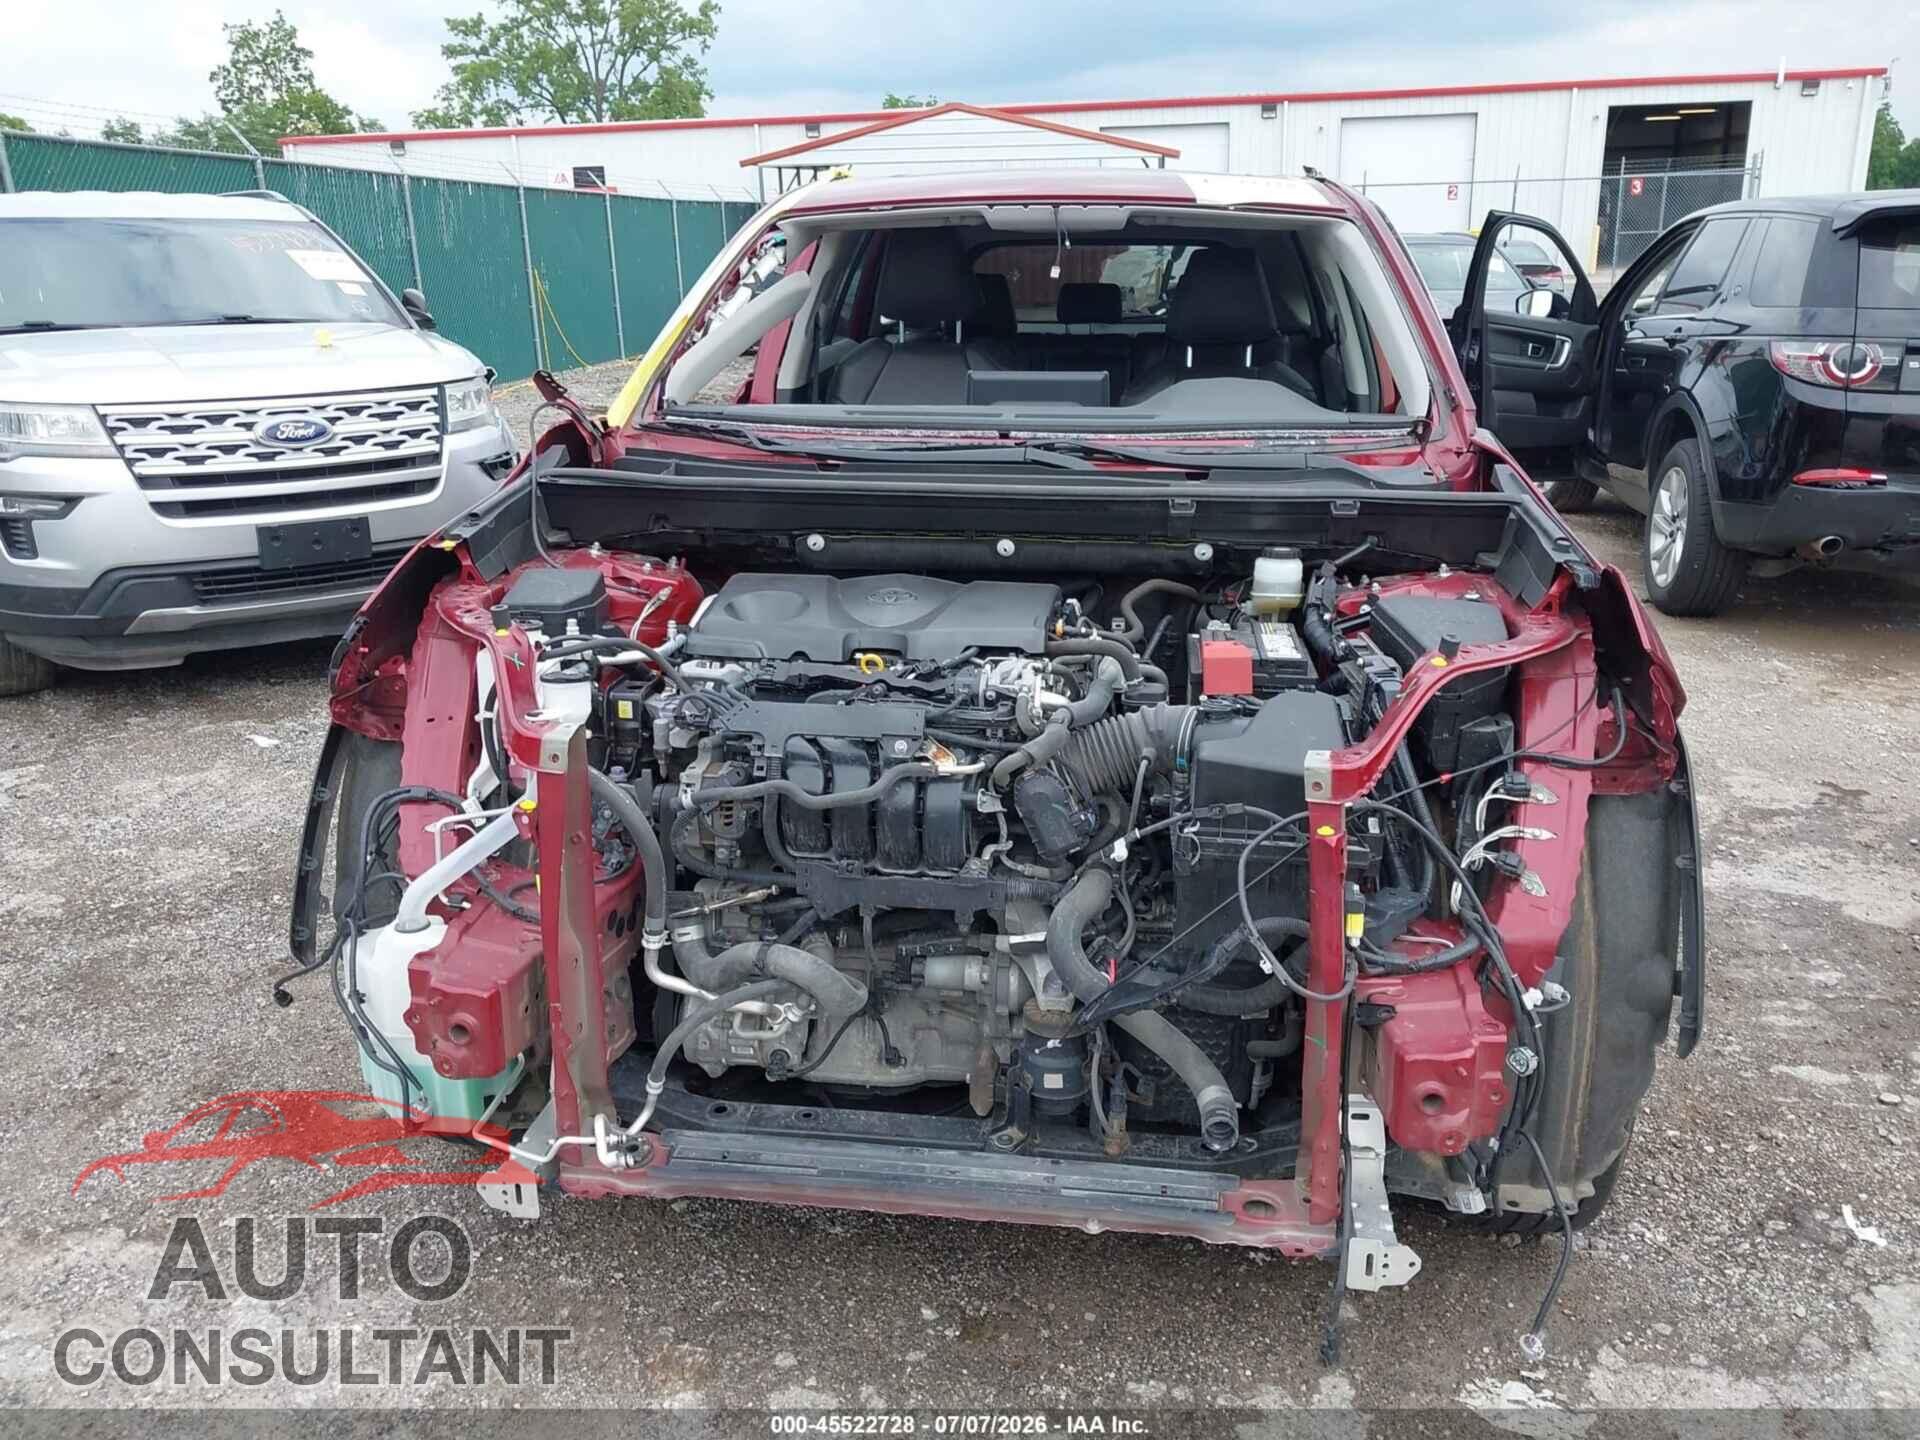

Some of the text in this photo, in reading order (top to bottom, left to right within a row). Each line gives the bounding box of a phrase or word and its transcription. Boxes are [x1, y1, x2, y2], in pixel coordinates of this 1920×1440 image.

[1448, 186, 1457, 199] 2
[1632, 180, 1641, 193] 3
[276, 422, 316, 439] Ford
